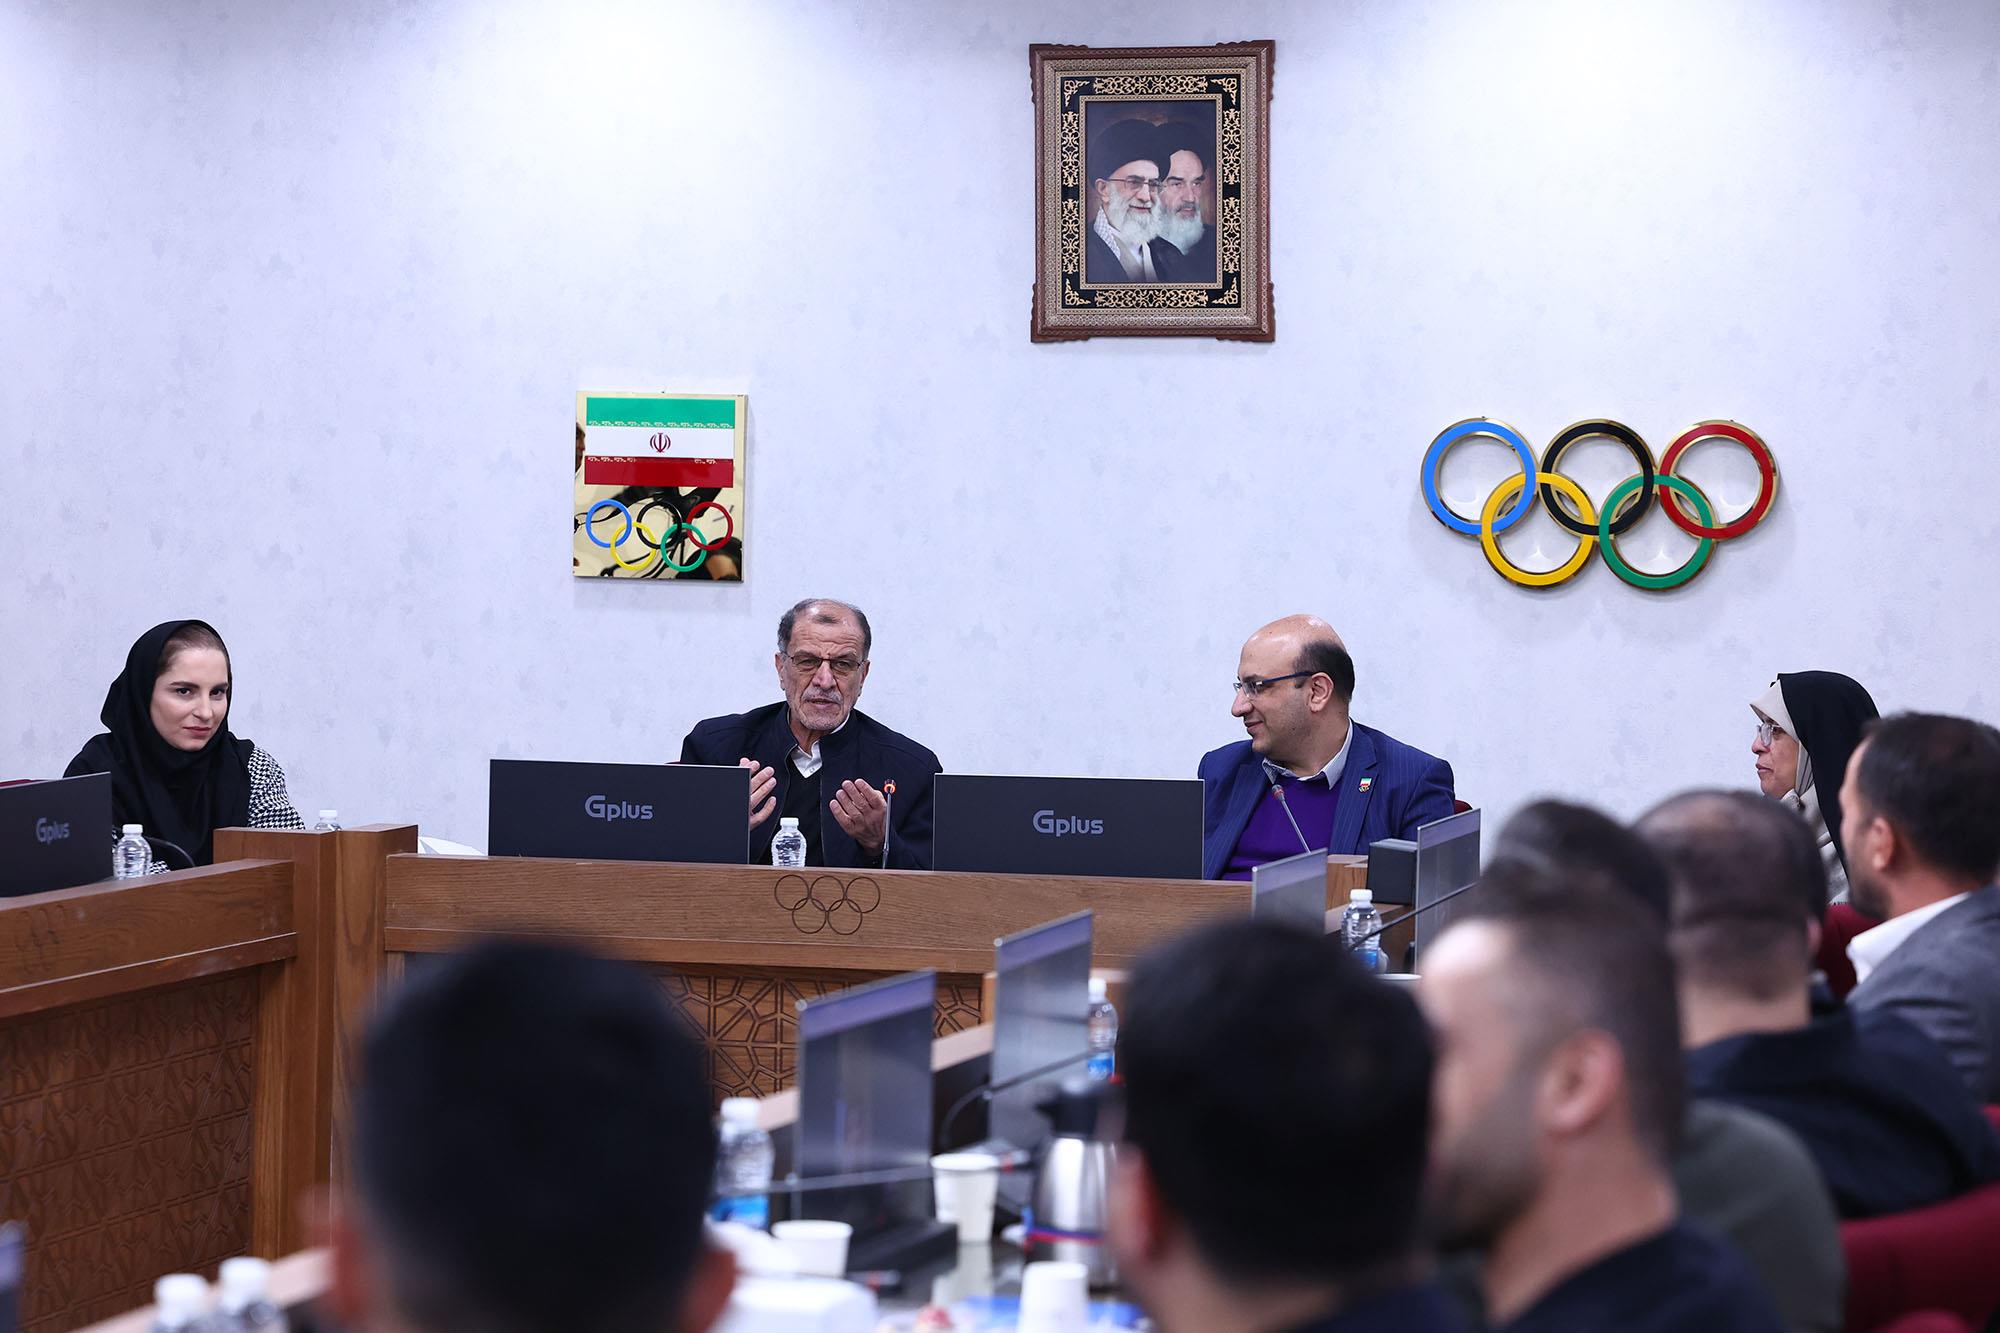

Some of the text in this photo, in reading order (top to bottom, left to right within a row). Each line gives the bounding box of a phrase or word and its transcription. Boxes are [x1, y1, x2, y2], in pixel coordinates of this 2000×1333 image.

[584, 794, 654, 821] Gplus
[36, 817, 70, 845] Gplus
[1032, 809, 1104, 837] Gplus
